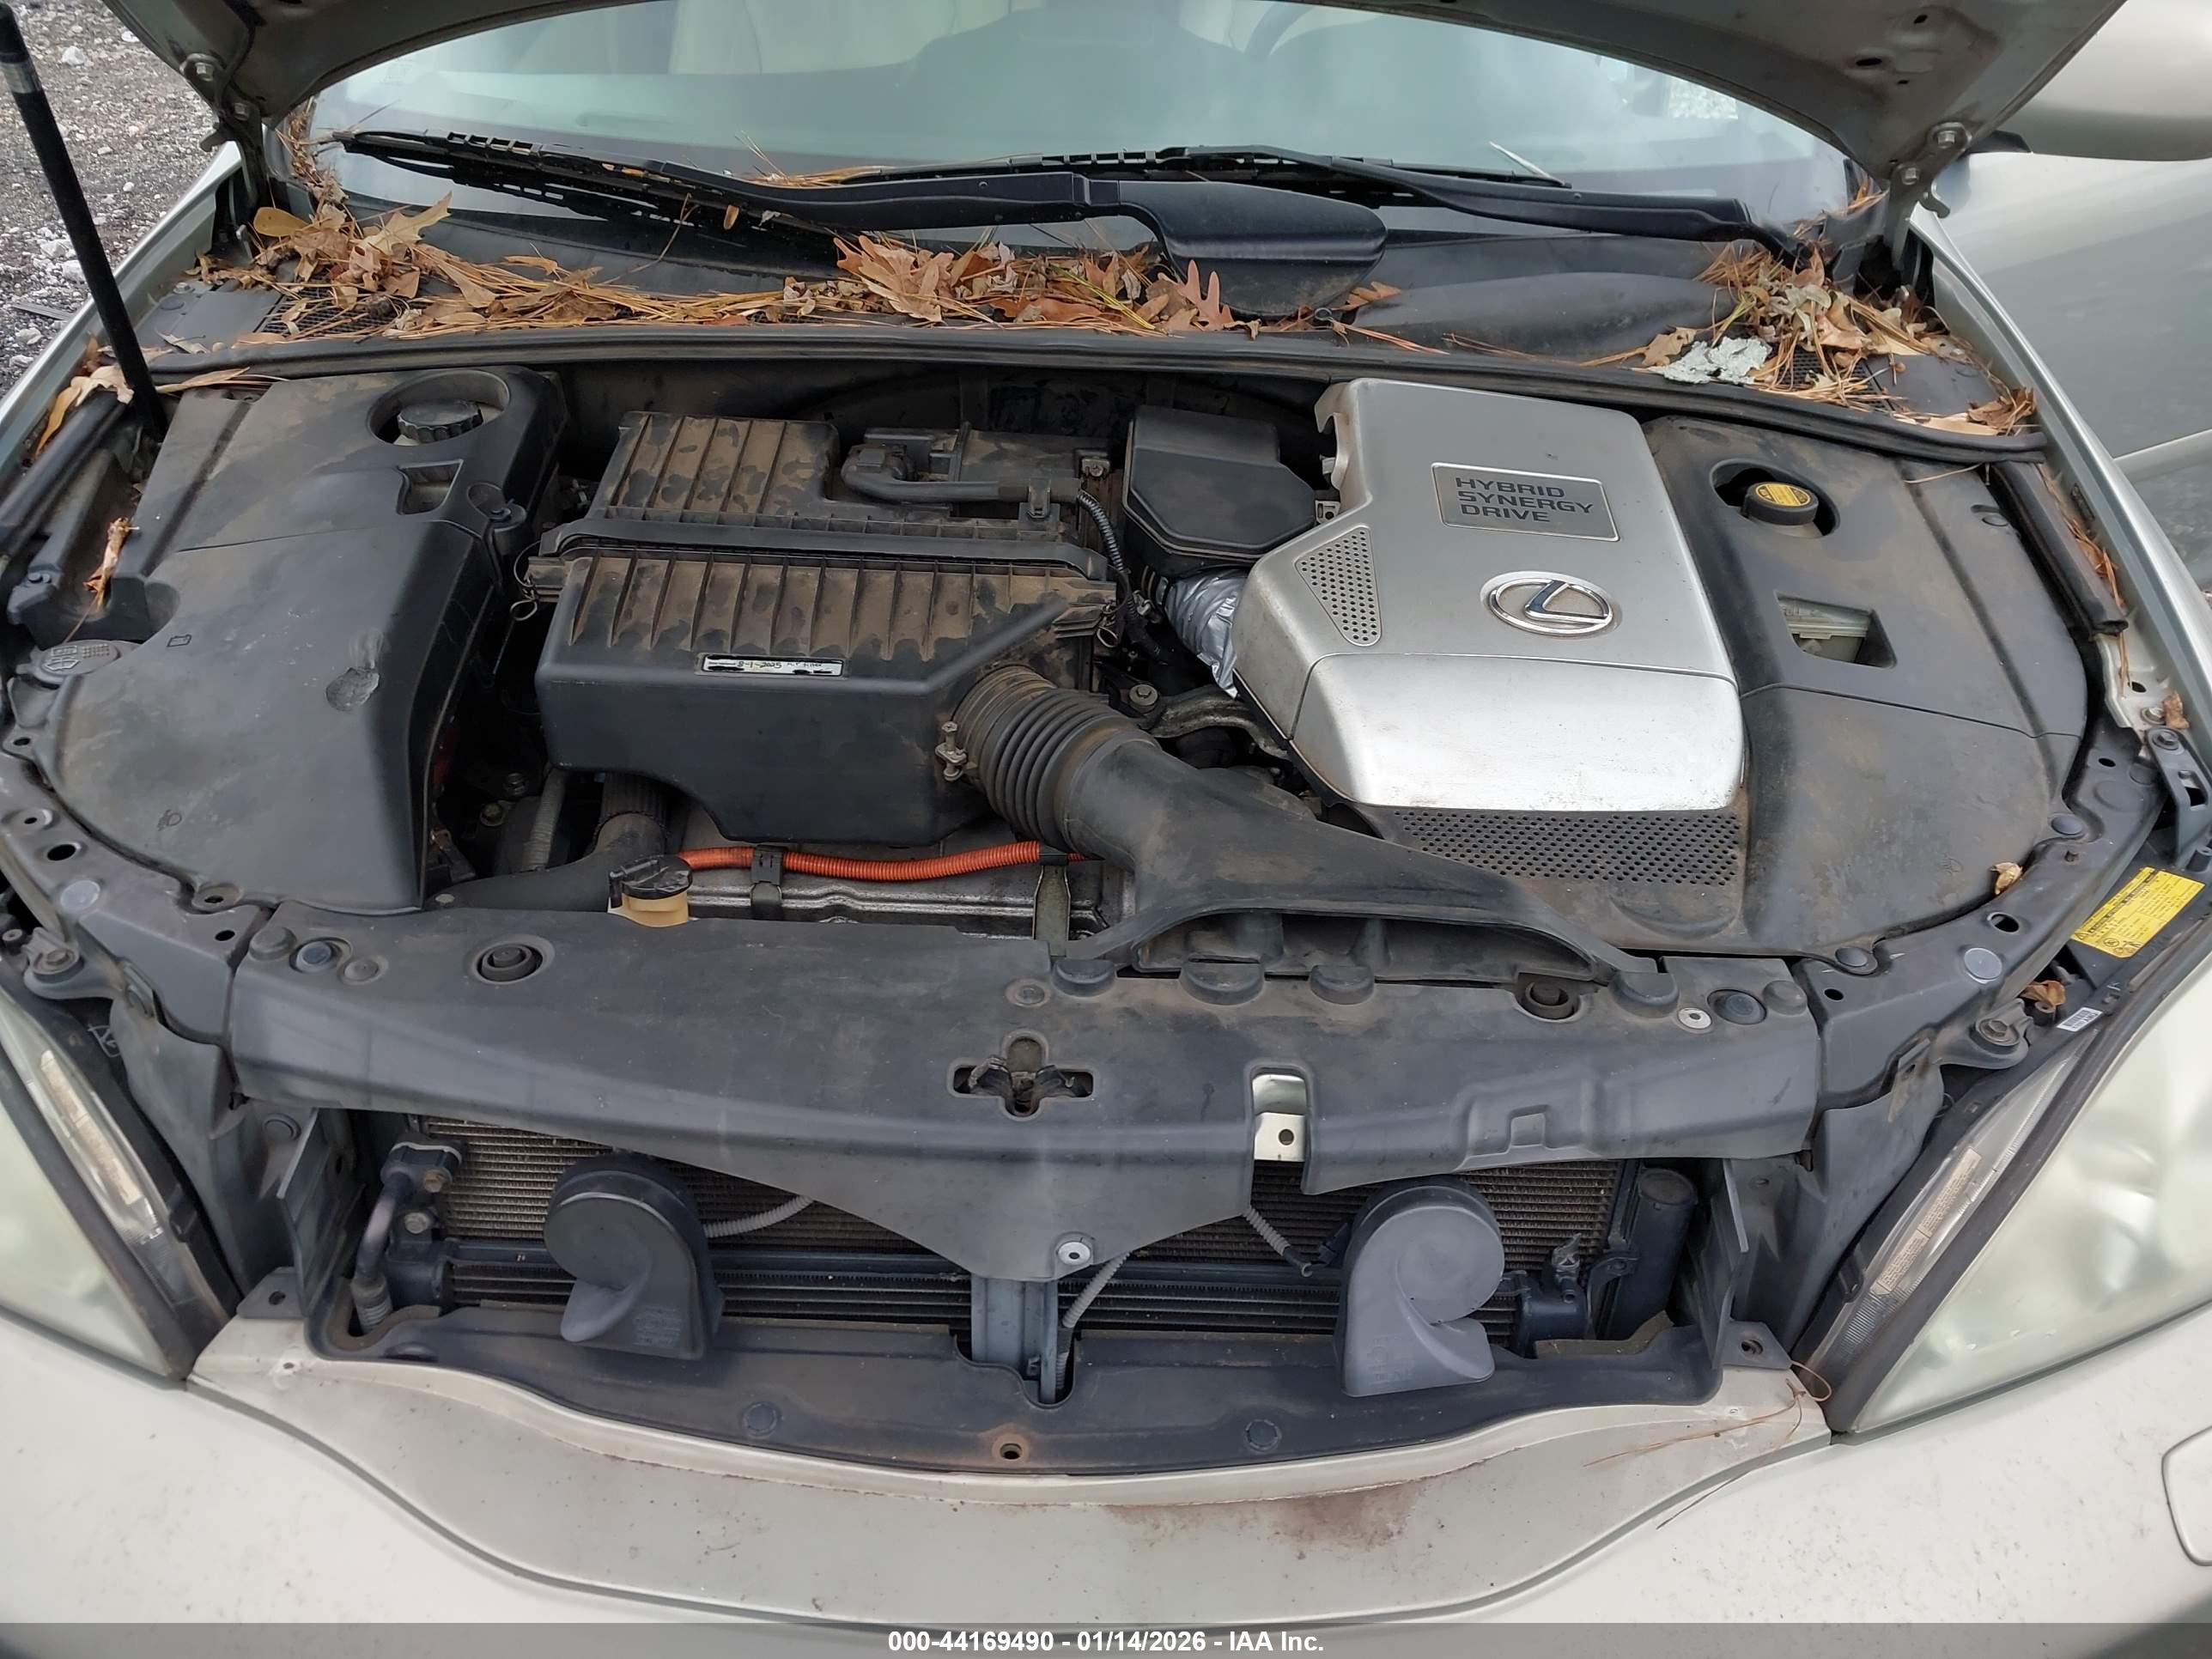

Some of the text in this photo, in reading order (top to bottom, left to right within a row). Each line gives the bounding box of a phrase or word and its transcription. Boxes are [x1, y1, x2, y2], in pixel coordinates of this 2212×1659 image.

[1455, 477, 1565, 498] HYBRID
[1457, 490, 1594, 514] SYNERGY
[1461, 504, 1551, 522] DRIVE
